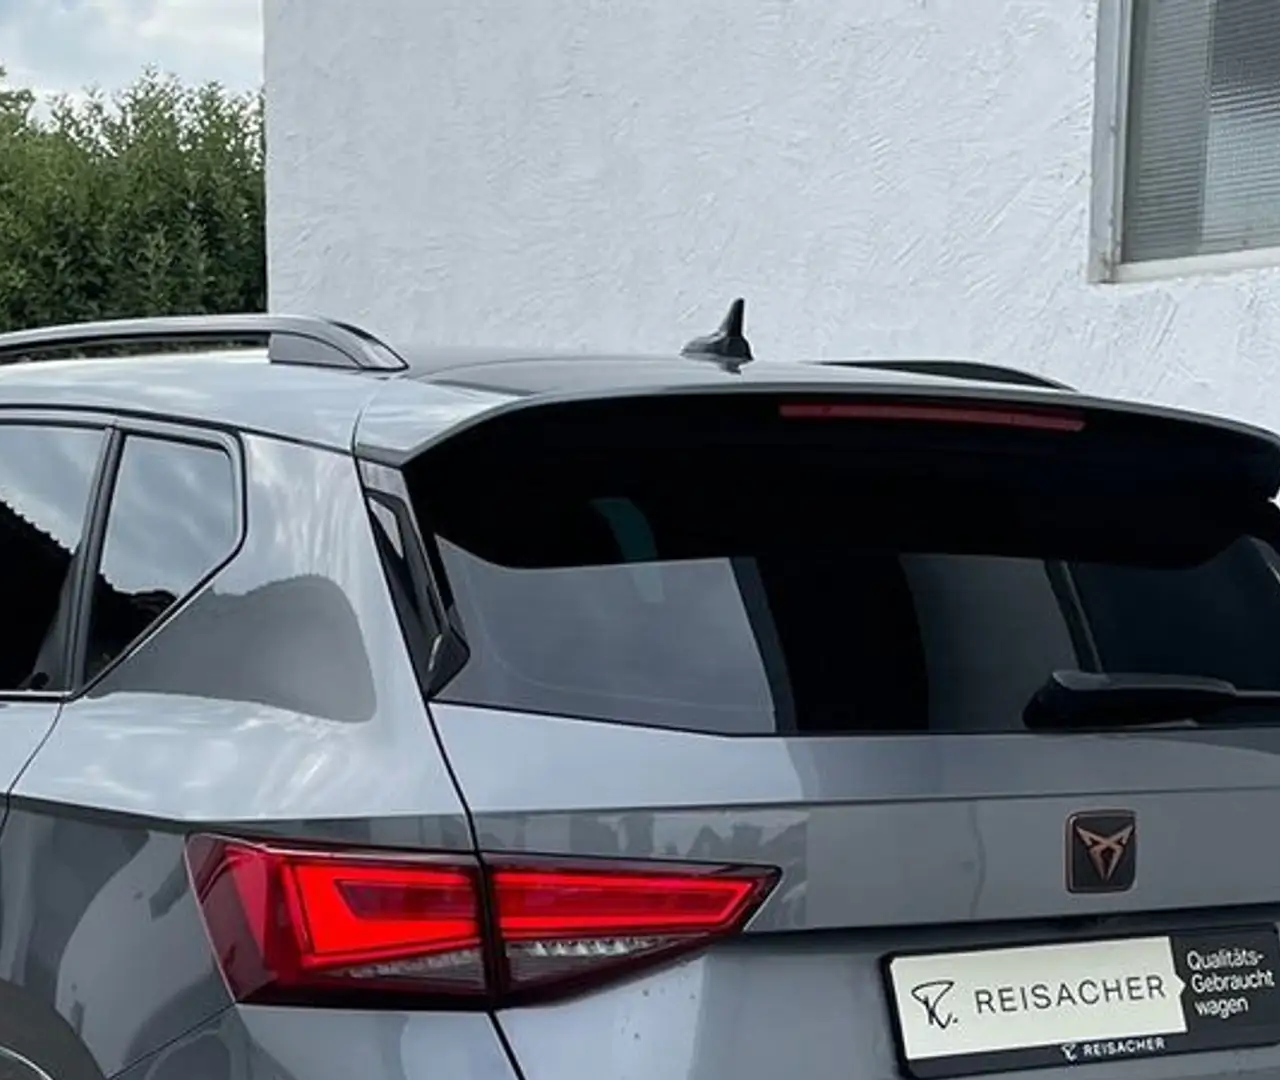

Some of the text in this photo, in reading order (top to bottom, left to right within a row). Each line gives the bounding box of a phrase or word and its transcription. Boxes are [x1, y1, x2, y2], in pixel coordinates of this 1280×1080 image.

[1187, 948, 1263, 971] Qualitäts-
[1192, 970, 1275, 993] Gebraucht
[974, 974, 1167, 1015] REISACHER
[1194, 997, 1248, 1019] wagen
[1083, 1037, 1165, 1057] REISACHER
